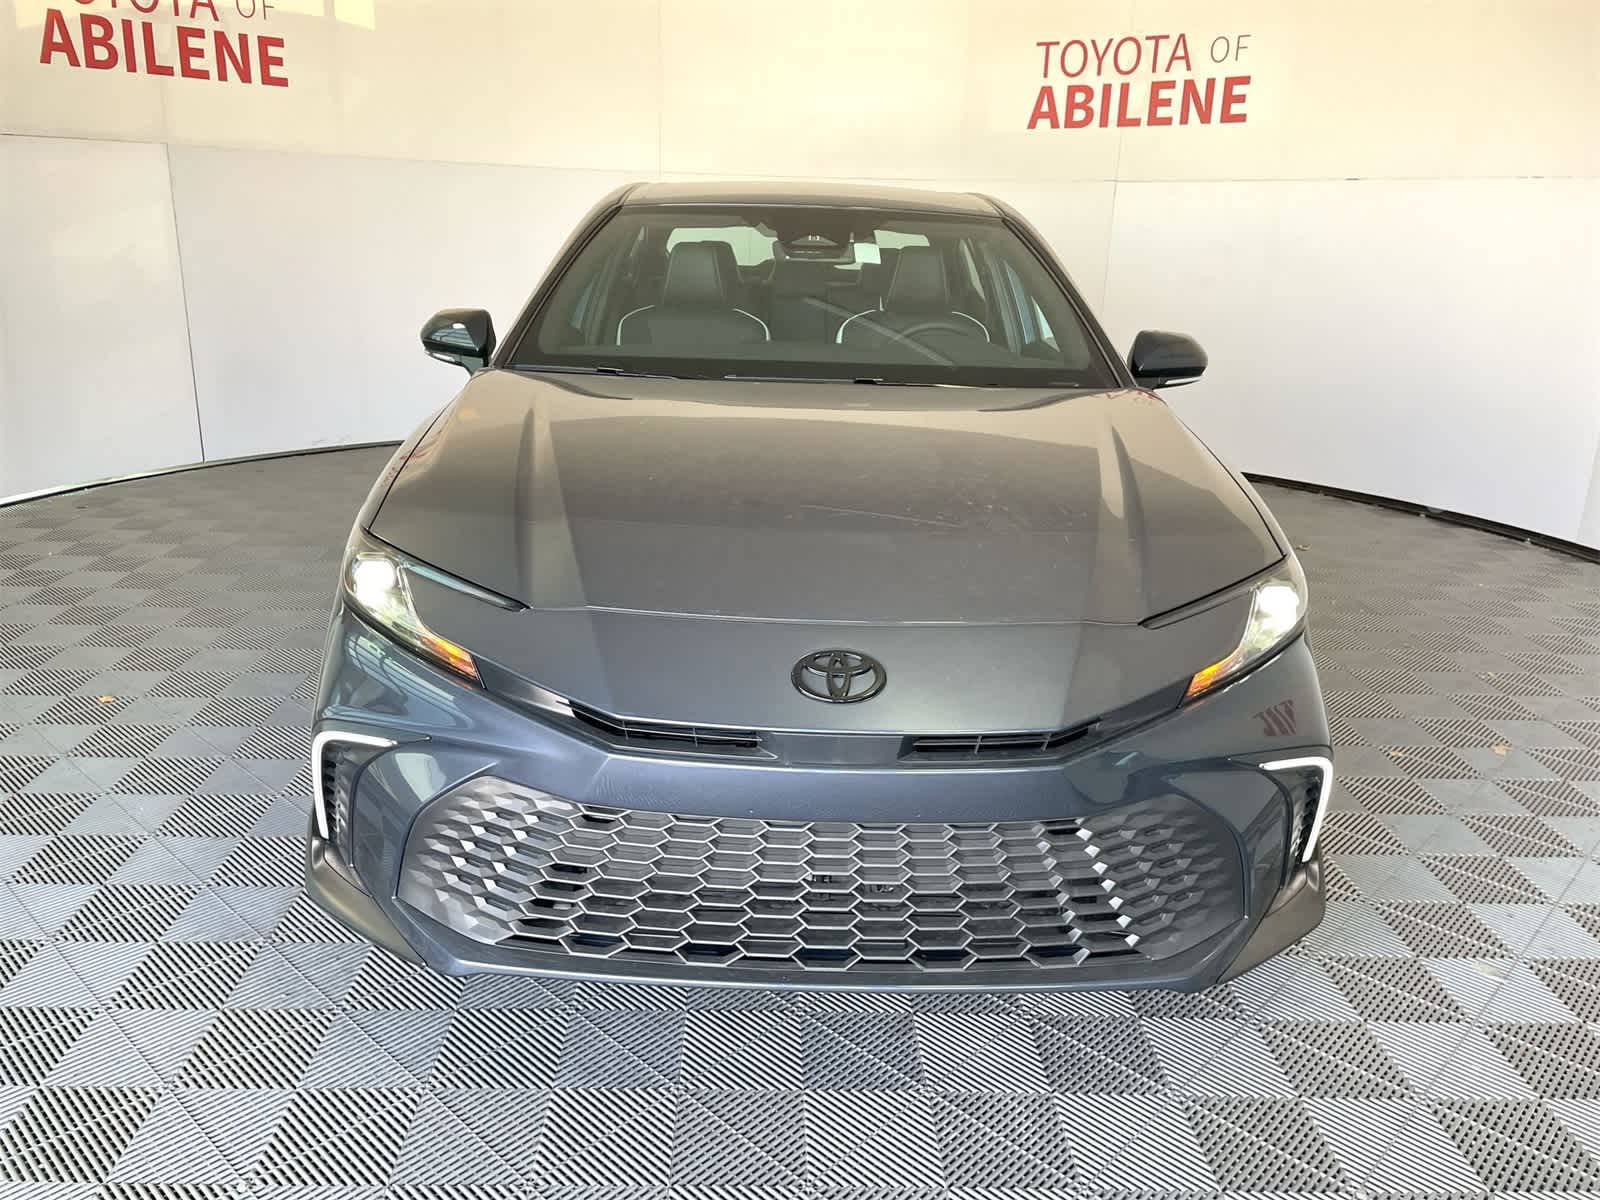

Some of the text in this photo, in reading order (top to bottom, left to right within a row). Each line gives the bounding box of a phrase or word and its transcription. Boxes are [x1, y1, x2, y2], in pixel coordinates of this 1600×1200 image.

[39, 8, 289, 87] ABILENE
[1036, 32, 1252, 78] TOYOTA OF
[1026, 75, 1252, 129] ABILENE
